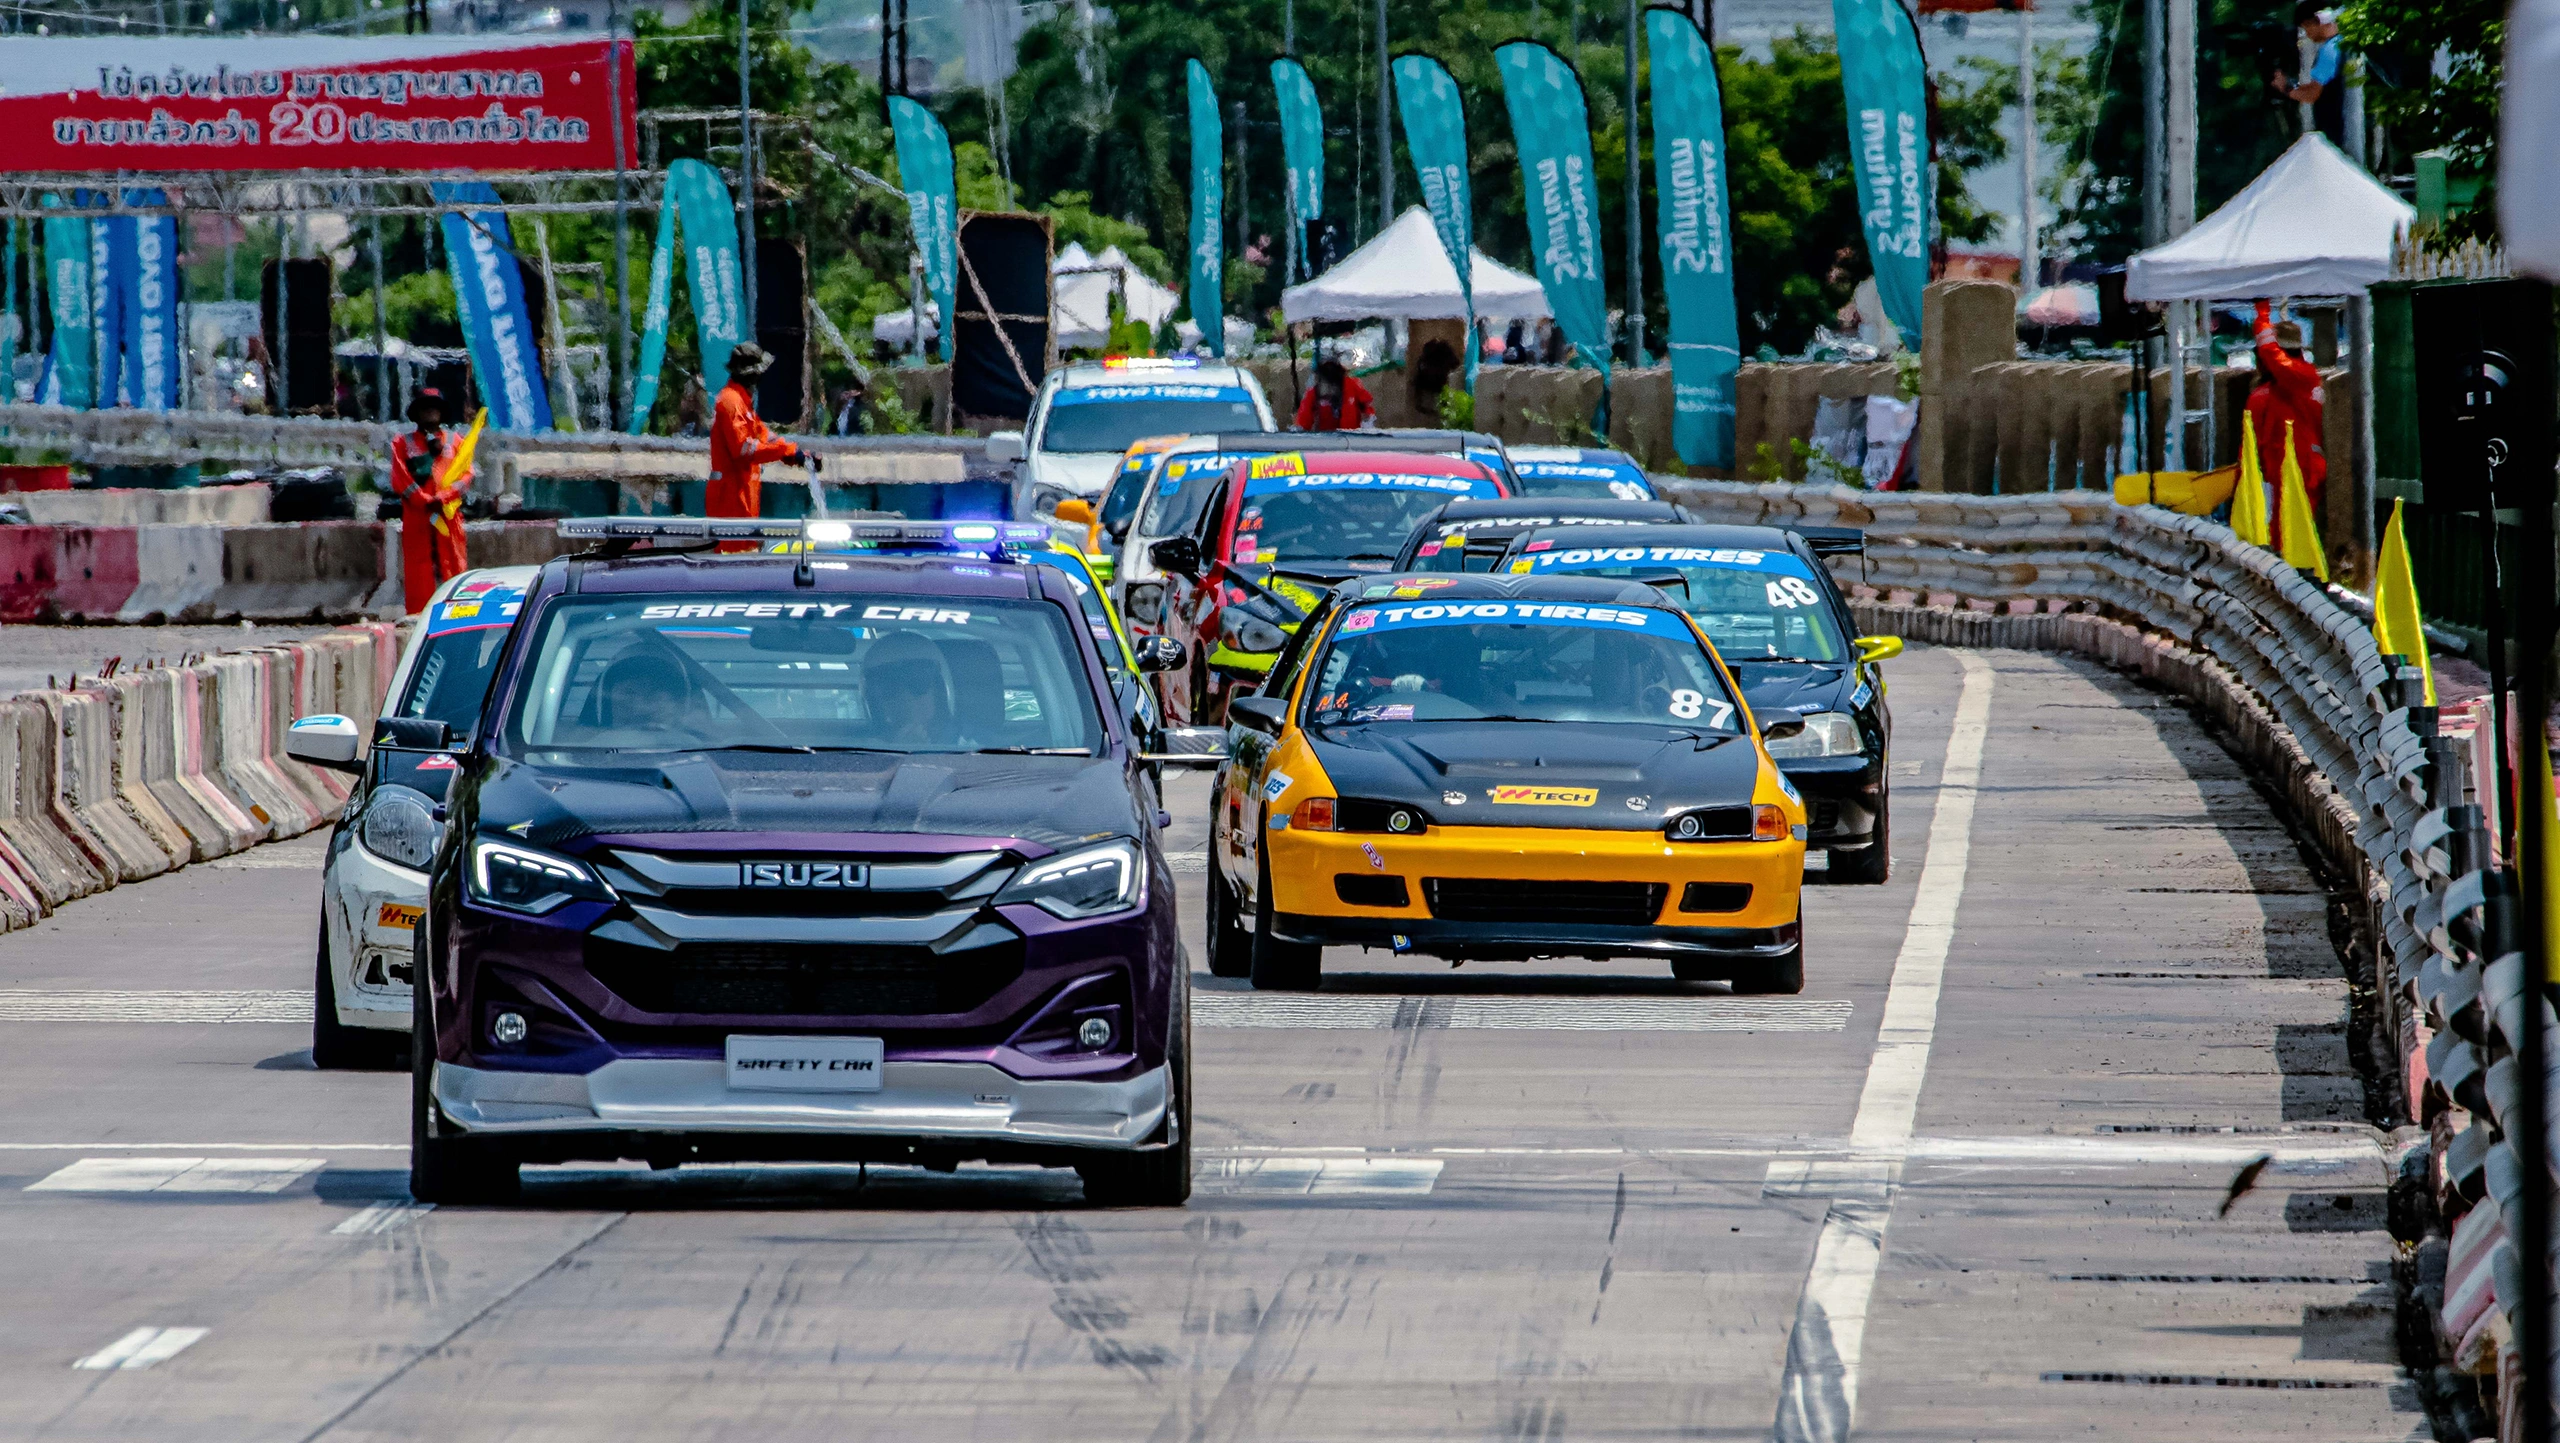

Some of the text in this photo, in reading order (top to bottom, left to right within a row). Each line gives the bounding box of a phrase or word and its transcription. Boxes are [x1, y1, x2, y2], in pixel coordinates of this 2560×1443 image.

[269, 101, 346, 146] 20
[1286, 473, 1473, 492] TOYO TIRES
[1538, 547, 1766, 567] TOYO TIRES
[1765, 577, 1819, 610] 48
[640, 603, 972, 624] SAFETY CAR
[1384, 603, 1649, 626] TOYO TIRES
[1668, 689, 1735, 730] 87
[743, 863, 869, 888] ISUZU
[735, 1059, 874, 1072] SAFETY CAR
